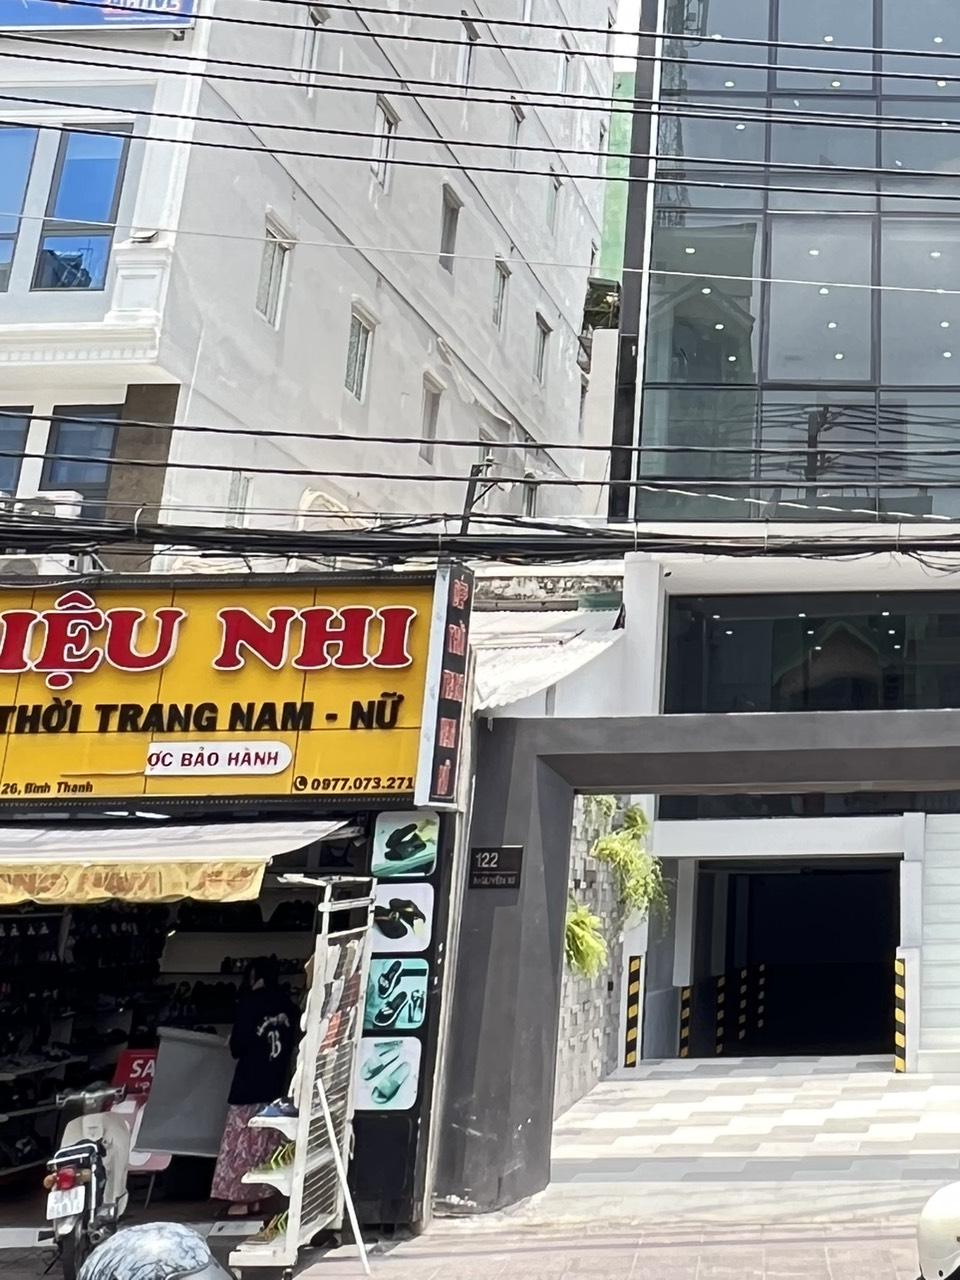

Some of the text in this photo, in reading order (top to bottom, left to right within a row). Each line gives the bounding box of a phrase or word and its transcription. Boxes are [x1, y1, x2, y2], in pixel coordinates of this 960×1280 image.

[211, 606, 416, 670] NHI
[0, 697, 82, 734] THỜI
[95, 702, 218, 733] TRANG
[228, 701, 315, 732] NAM
[350, 692, 405, 730] NỮ
[180, 746, 219, 767] BẢO
[227, 746, 279, 766] HÀNH
[475, 852, 498, 867] 122
